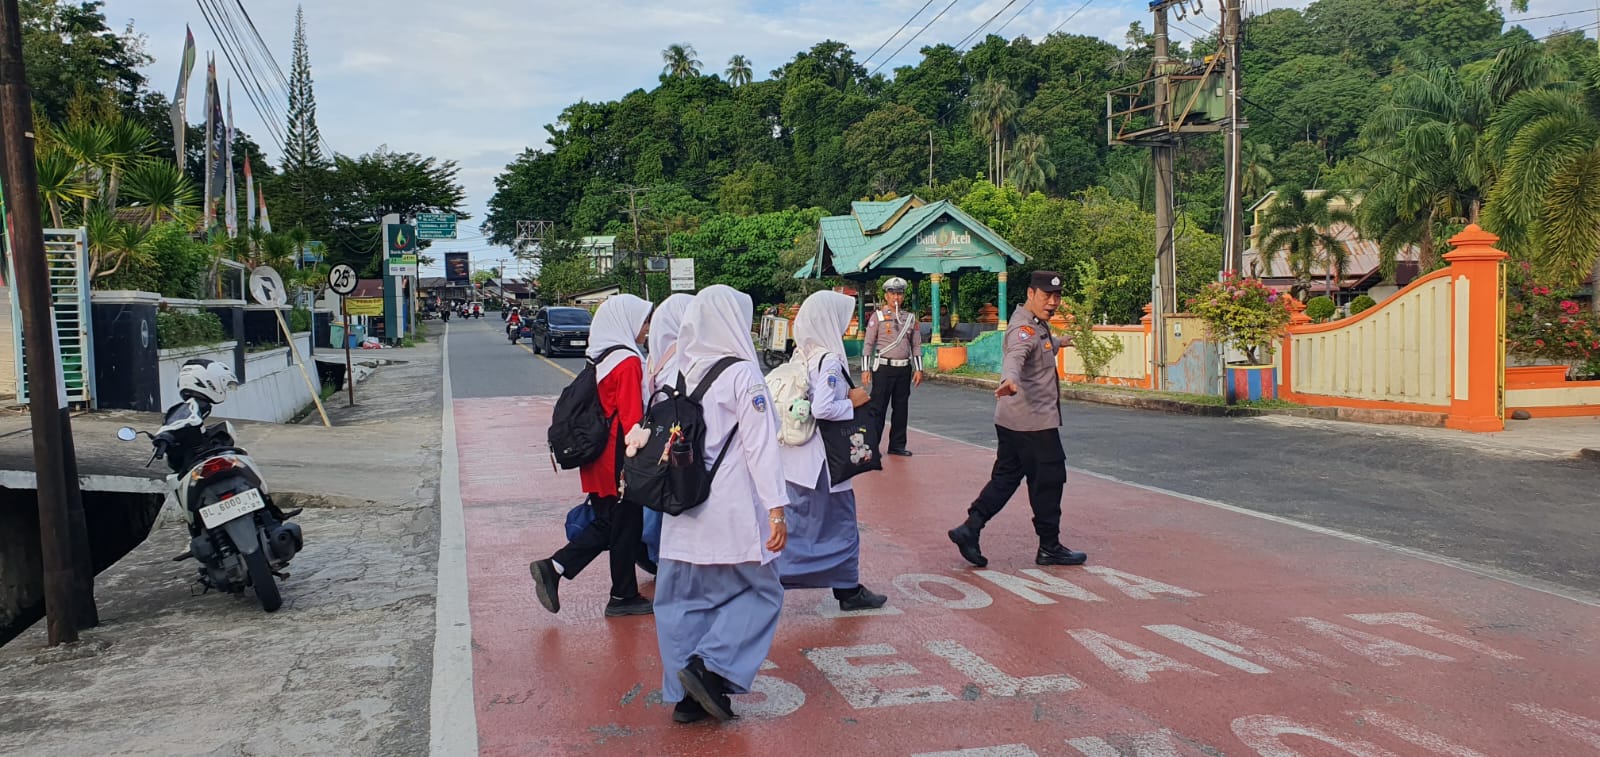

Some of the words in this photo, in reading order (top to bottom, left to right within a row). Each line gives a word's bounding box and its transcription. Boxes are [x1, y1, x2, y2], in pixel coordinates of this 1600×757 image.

[916, 231, 937, 245] Bank
[951, 230, 971, 245] Aceh
[333, 268, 349, 288] 25
[202, 508, 215, 519] BL
[219, 497, 241, 511] 6000
